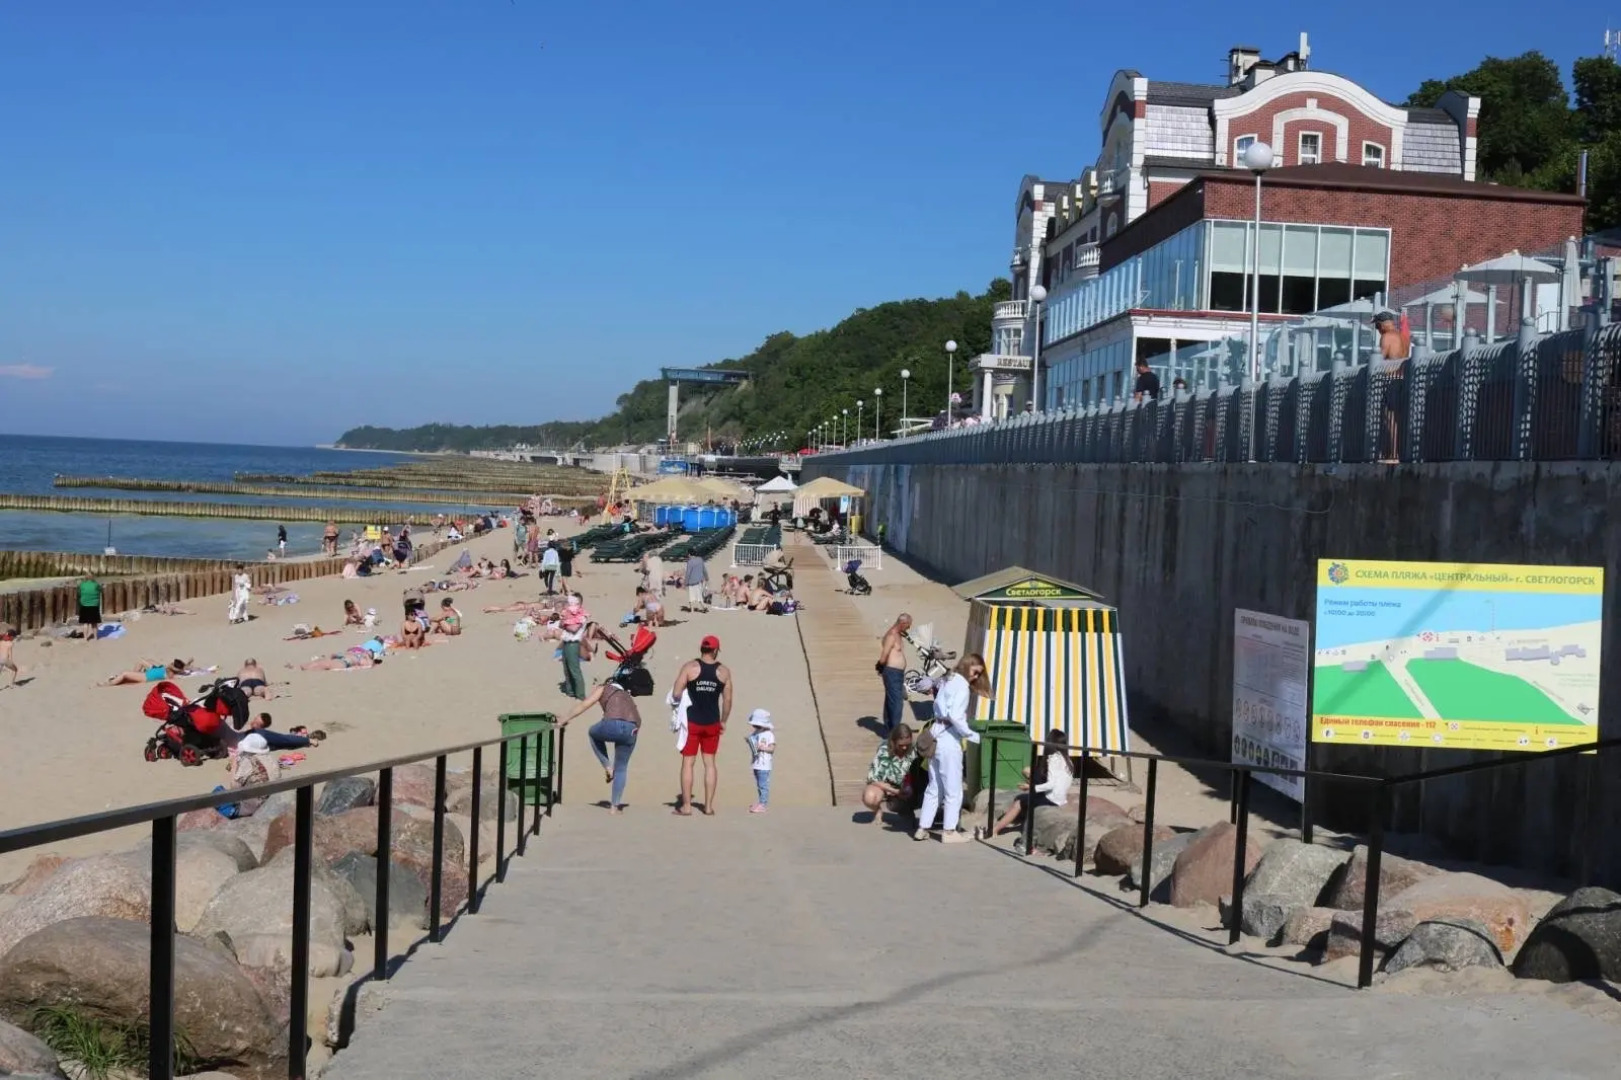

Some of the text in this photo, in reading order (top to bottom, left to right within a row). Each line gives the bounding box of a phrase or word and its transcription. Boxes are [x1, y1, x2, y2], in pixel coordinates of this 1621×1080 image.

[1355, 569, 1389, 579] СХЕМА
[1391, 570, 1427, 580] ПЛЯЖА
[1429, 571, 1512, 583] «ЦЕНТРАЛЬНЫЙ»
[1525, 575, 1595, 585] СВЕТЛОГОРСК
[1350, 599, 1377, 608] работы
[1320, 716, 1350, 726] Единый
[1351, 718, 1383, 727] телефон
[1385, 720, 1420, 728] спасения
